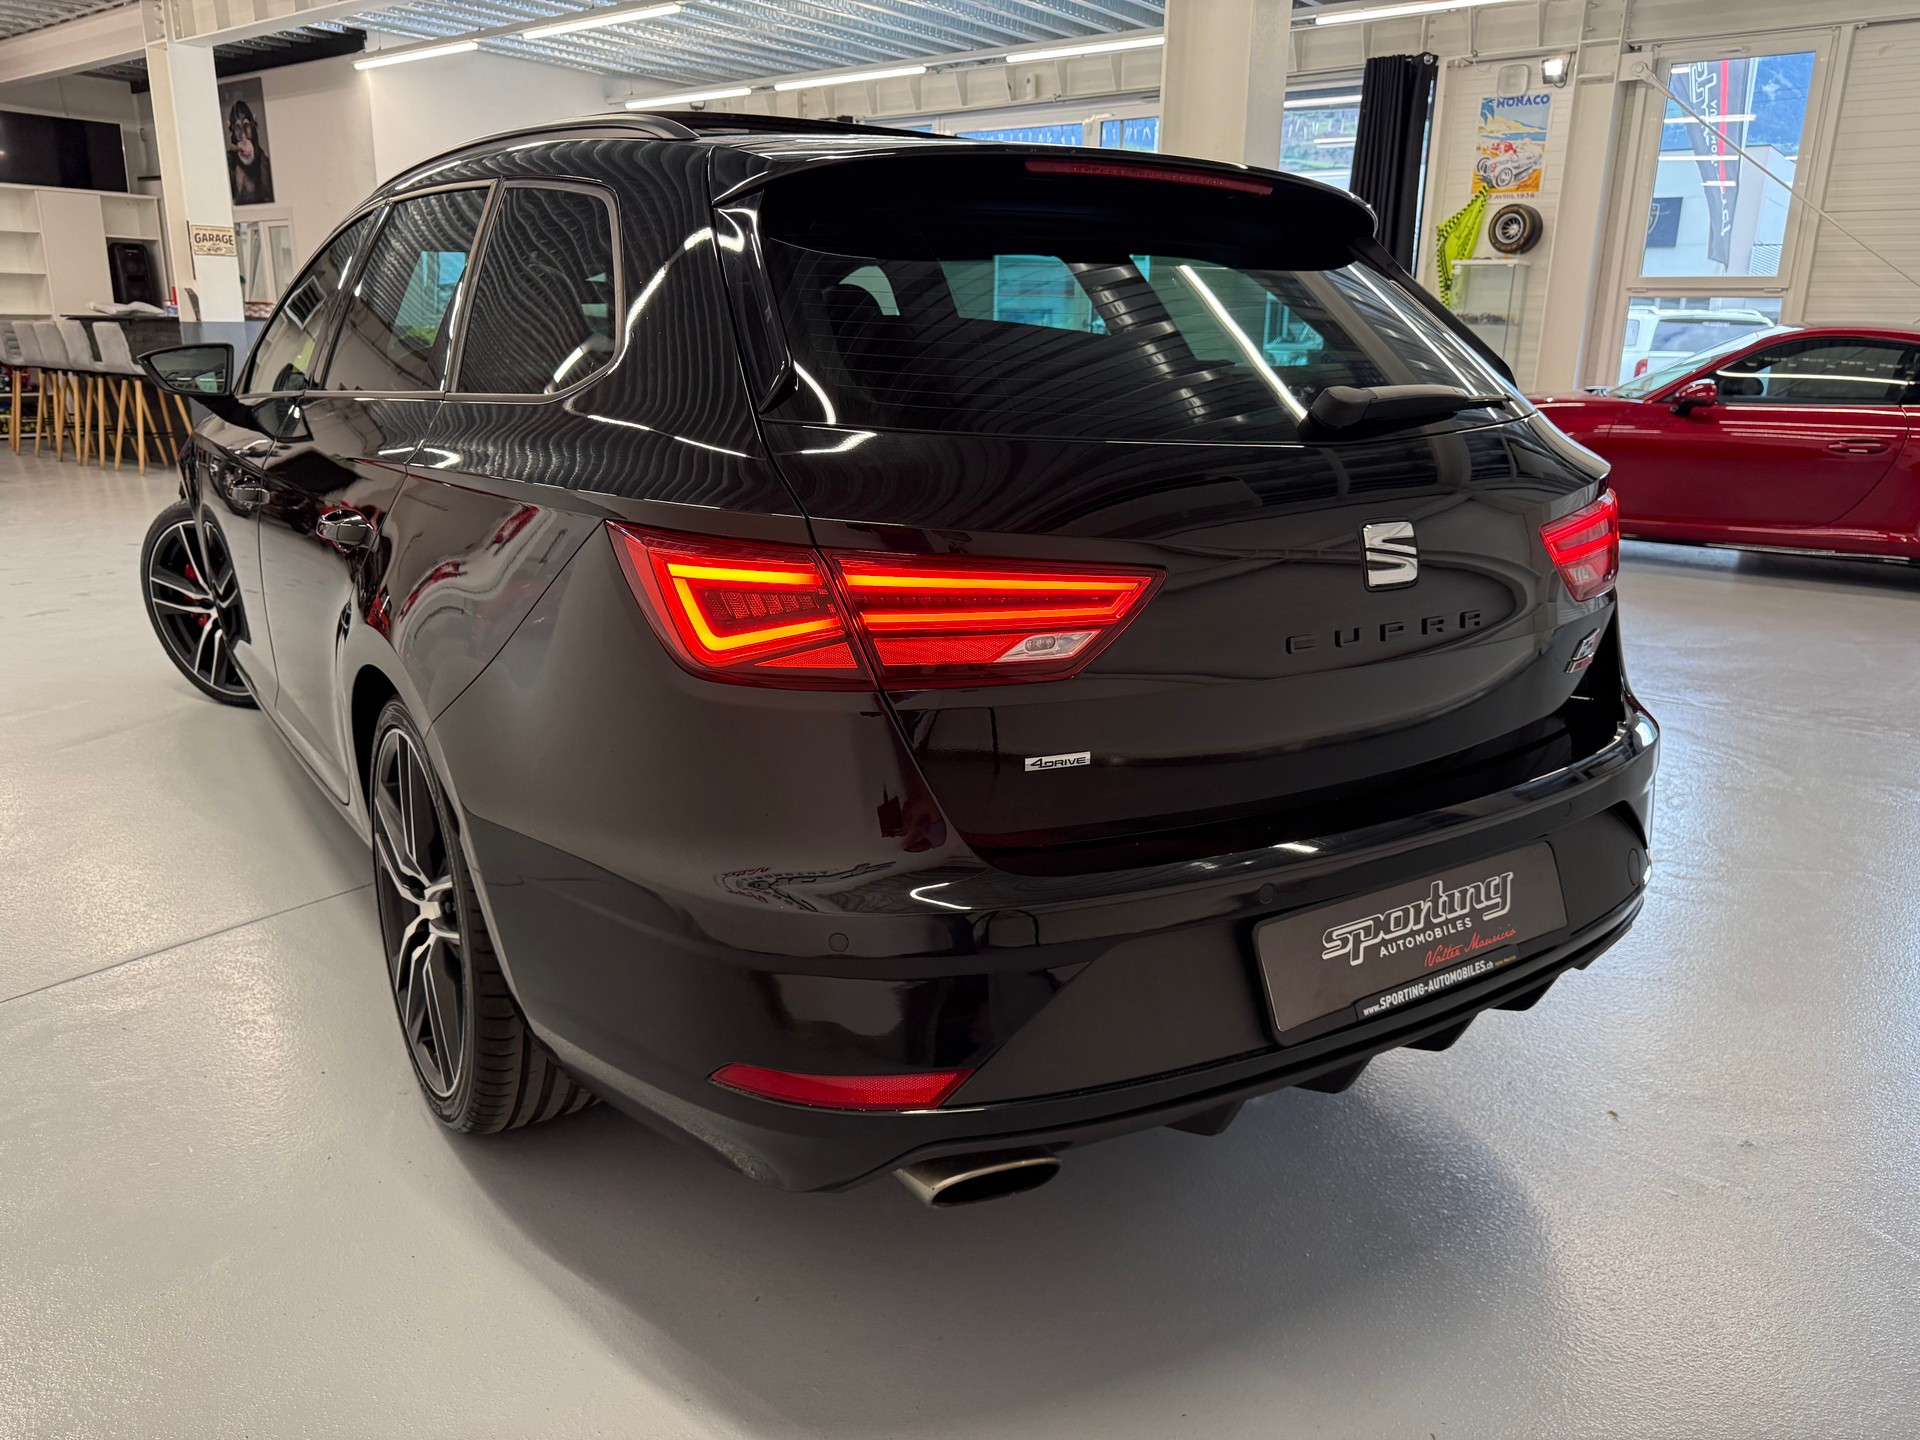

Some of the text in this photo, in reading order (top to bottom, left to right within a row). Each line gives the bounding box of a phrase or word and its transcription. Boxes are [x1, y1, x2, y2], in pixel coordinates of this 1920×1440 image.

[1496, 94, 1551, 108] MONACO
[194, 232, 234, 246] GARAGE
[1285, 609, 1482, 655] CUPRA
[1030, 757, 1087, 769] 4DRIVE
[1379, 917, 1473, 958] AUTOMOBILES
[1362, 960, 1494, 1016] www.SPORTING-AUTOMOBILES.ch
